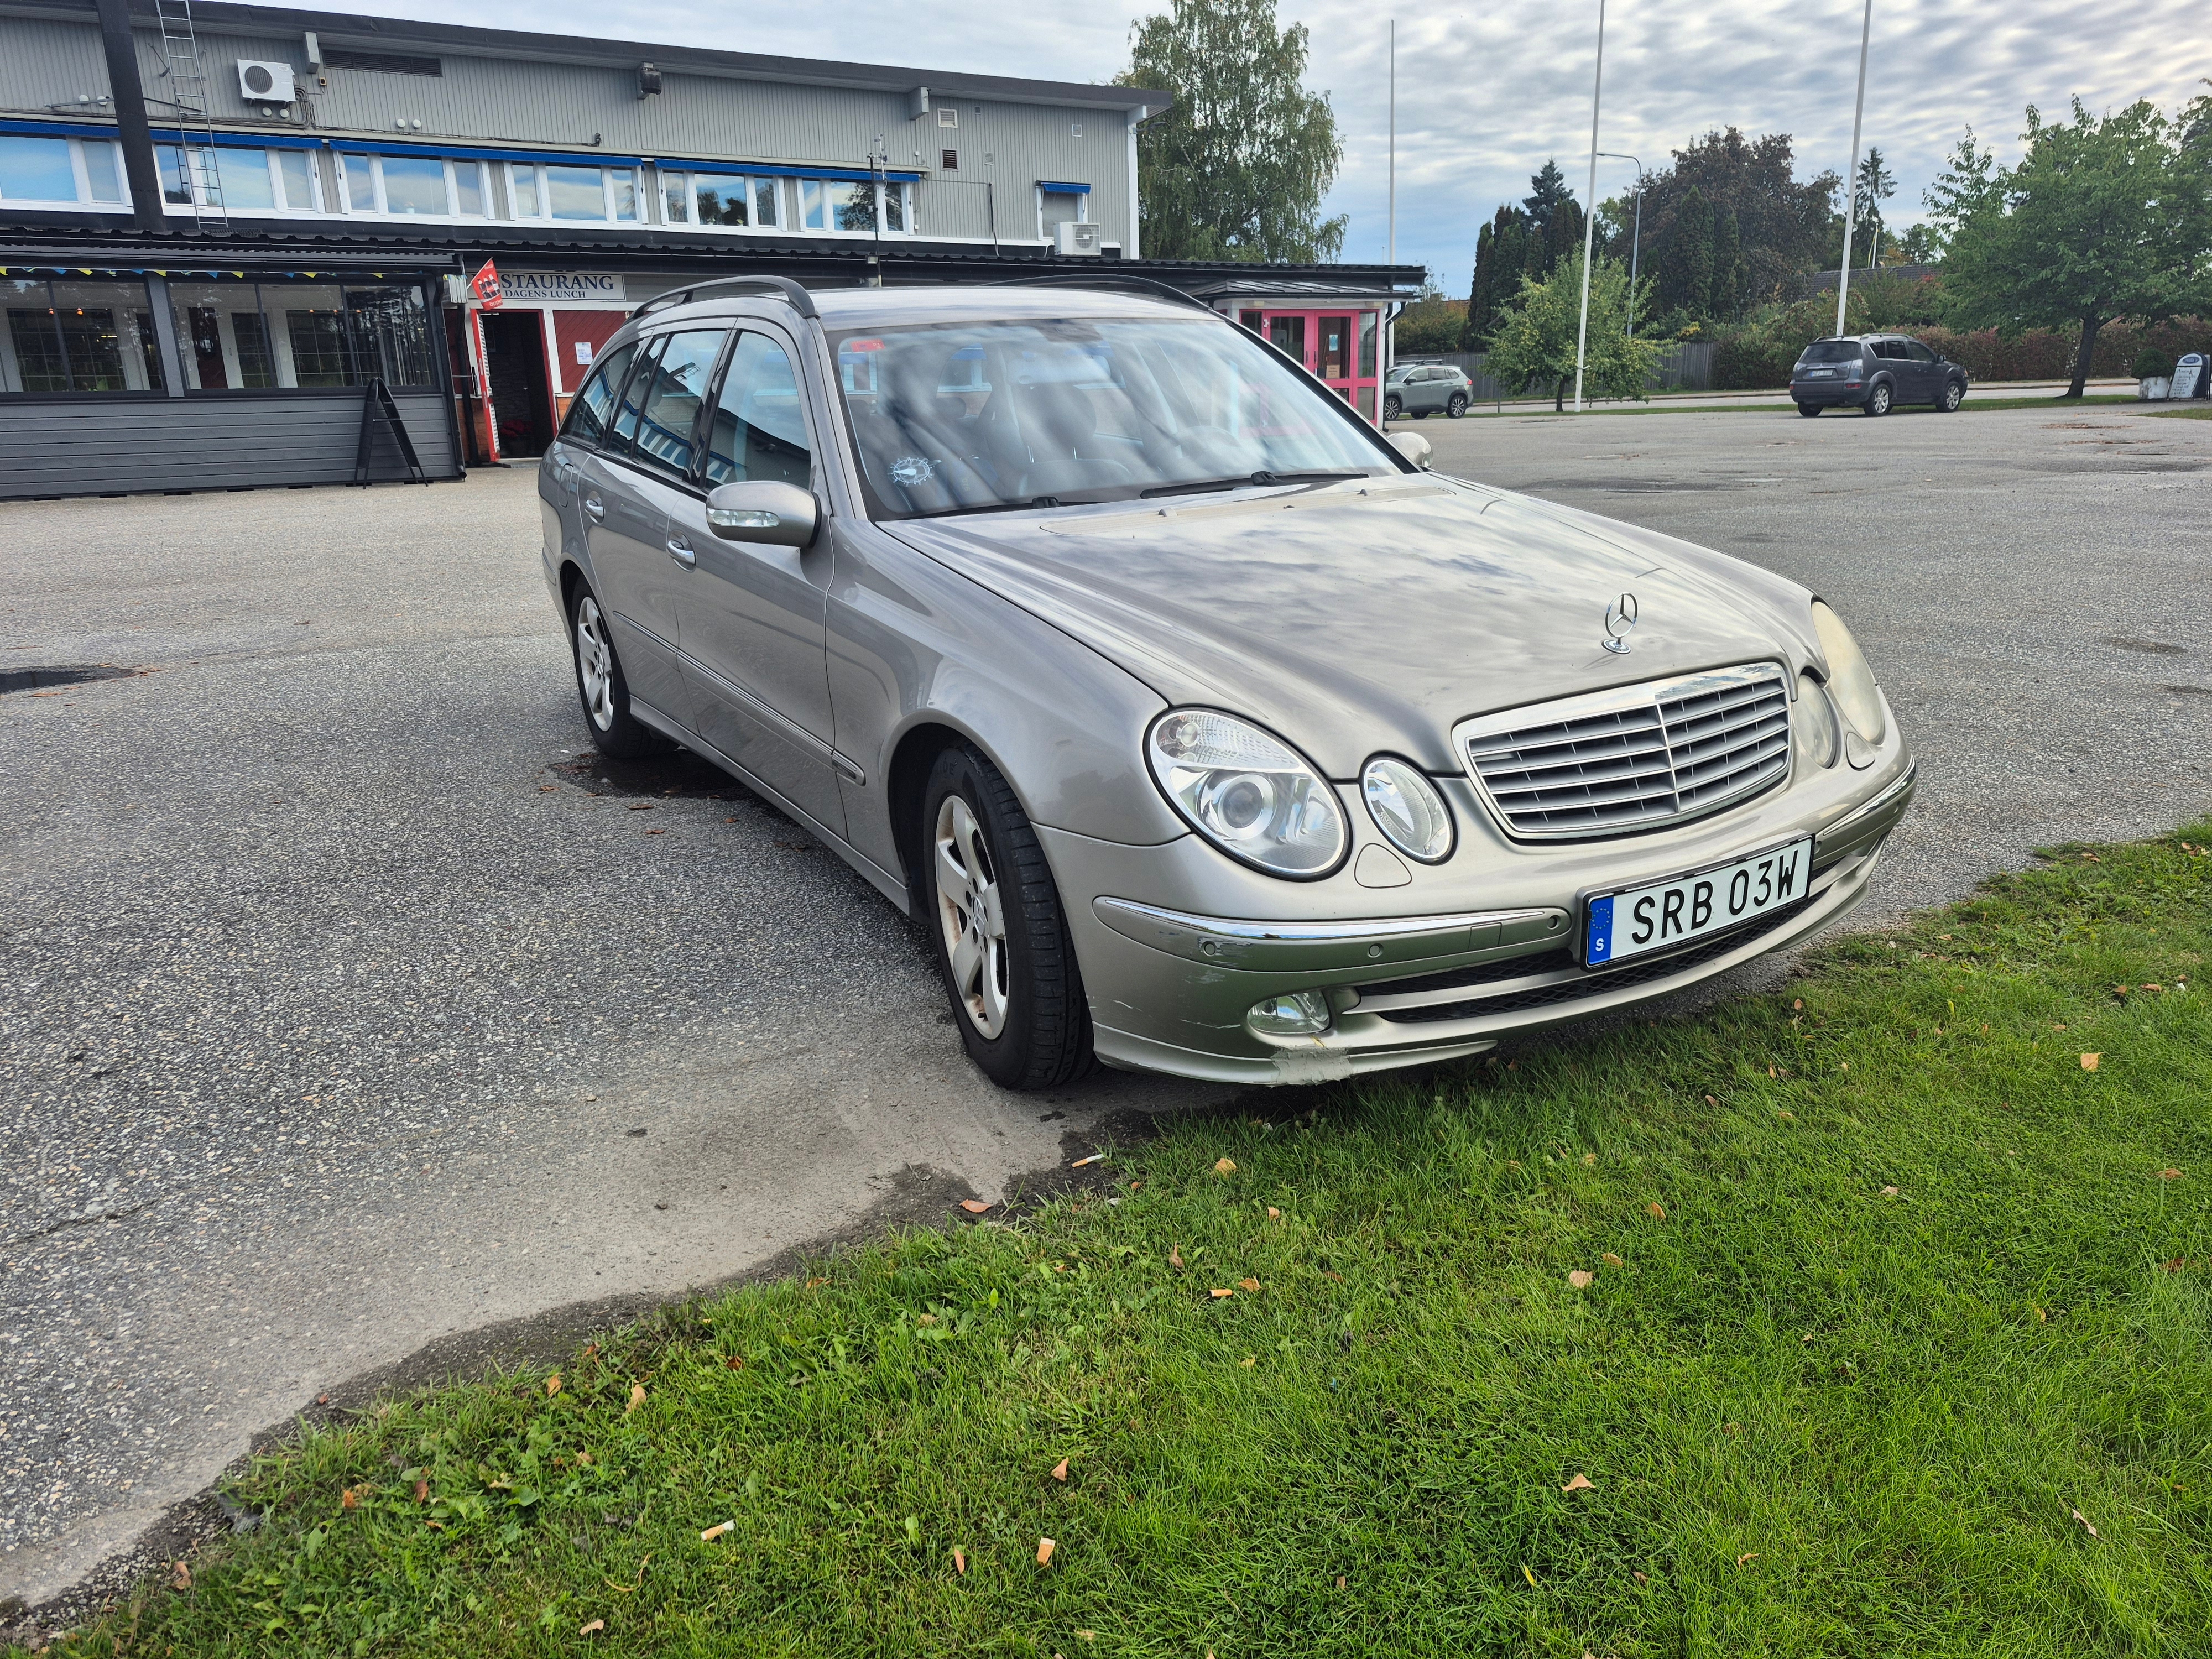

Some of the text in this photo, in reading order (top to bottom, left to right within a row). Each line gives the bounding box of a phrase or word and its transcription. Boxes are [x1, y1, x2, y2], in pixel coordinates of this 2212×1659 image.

[471, 273, 614, 290] STAURANG
[505, 289, 547, 298] DAGENS
[1631, 849, 1799, 945] SRB 03W
[1595, 938, 1605, 952] S
